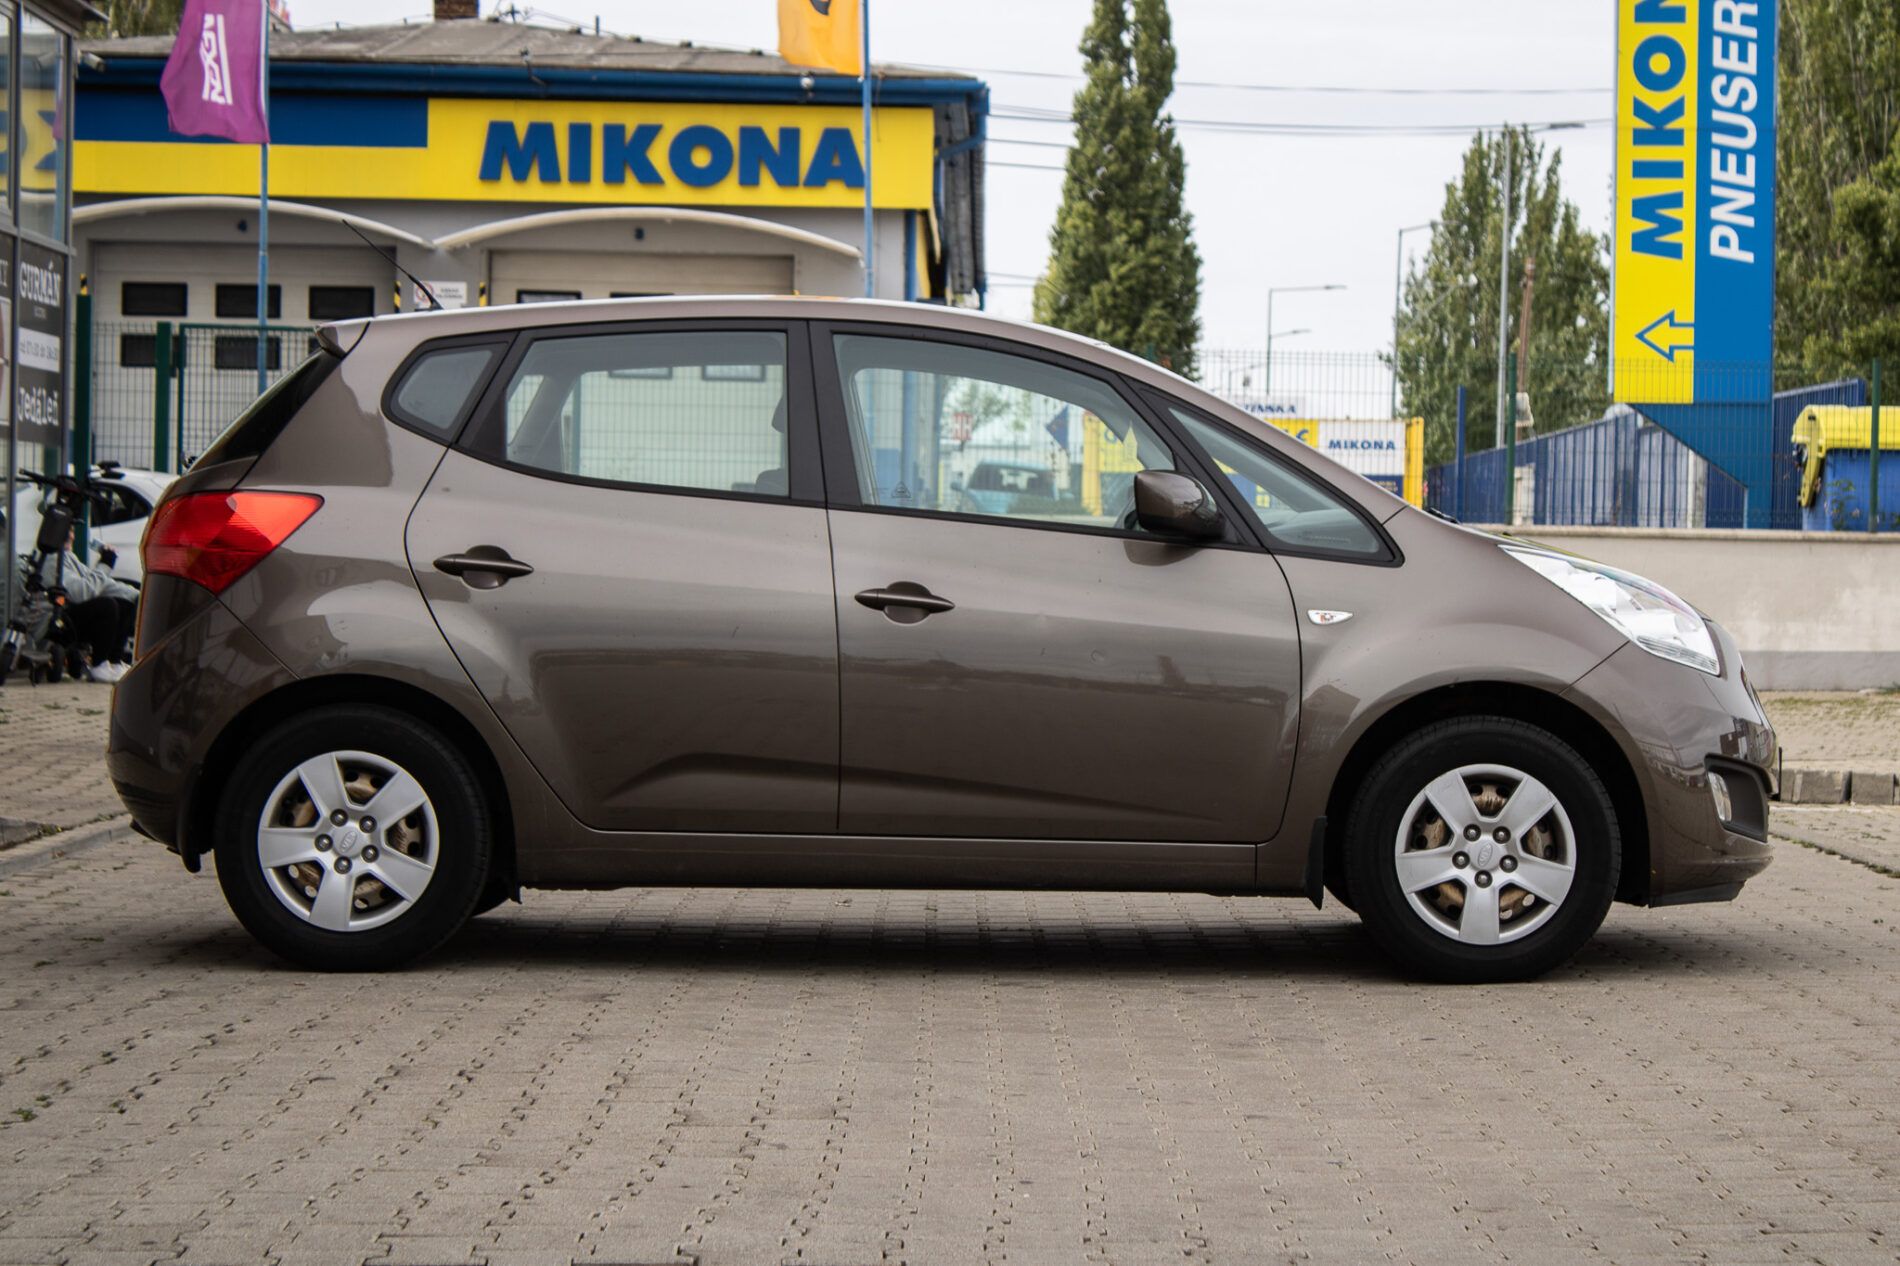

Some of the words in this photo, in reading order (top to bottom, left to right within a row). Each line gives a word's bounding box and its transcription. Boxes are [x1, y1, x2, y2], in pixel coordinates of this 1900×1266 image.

[479, 121, 866, 188] MIKONA
[20, 260, 61, 307] GURMÁN
[1328, 440, 1396, 450] MIKONA
